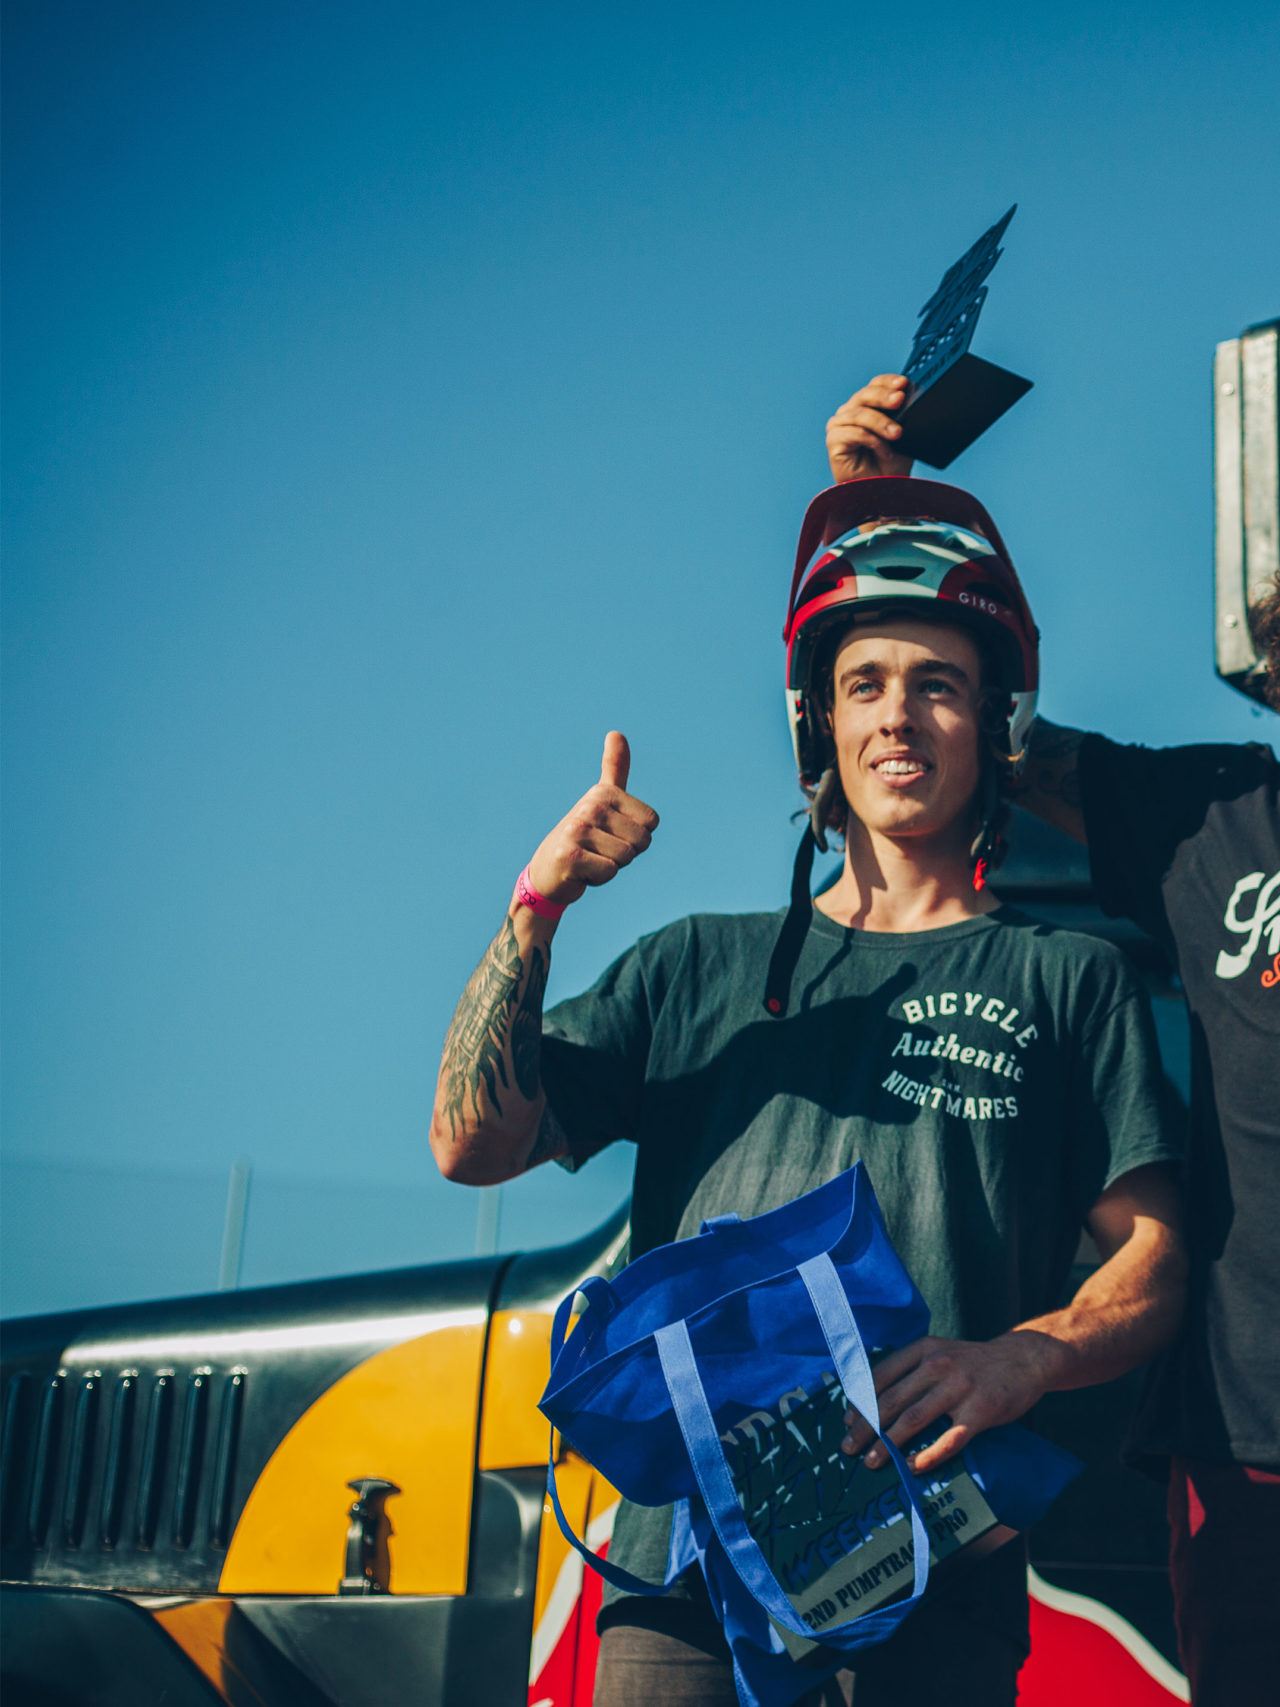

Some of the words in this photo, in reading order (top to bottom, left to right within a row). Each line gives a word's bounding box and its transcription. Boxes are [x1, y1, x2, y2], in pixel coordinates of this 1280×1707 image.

[958, 592, 998, 615] GIRO
[902, 991, 1038, 1048] BICYCLE
[891, 1032, 1024, 1082] Authentic
[882, 1070, 1018, 1120] NIGHTMARES
[834, 1538, 917, 1610] PUMPTRAC
[932, 1507, 968, 1546] PRO
